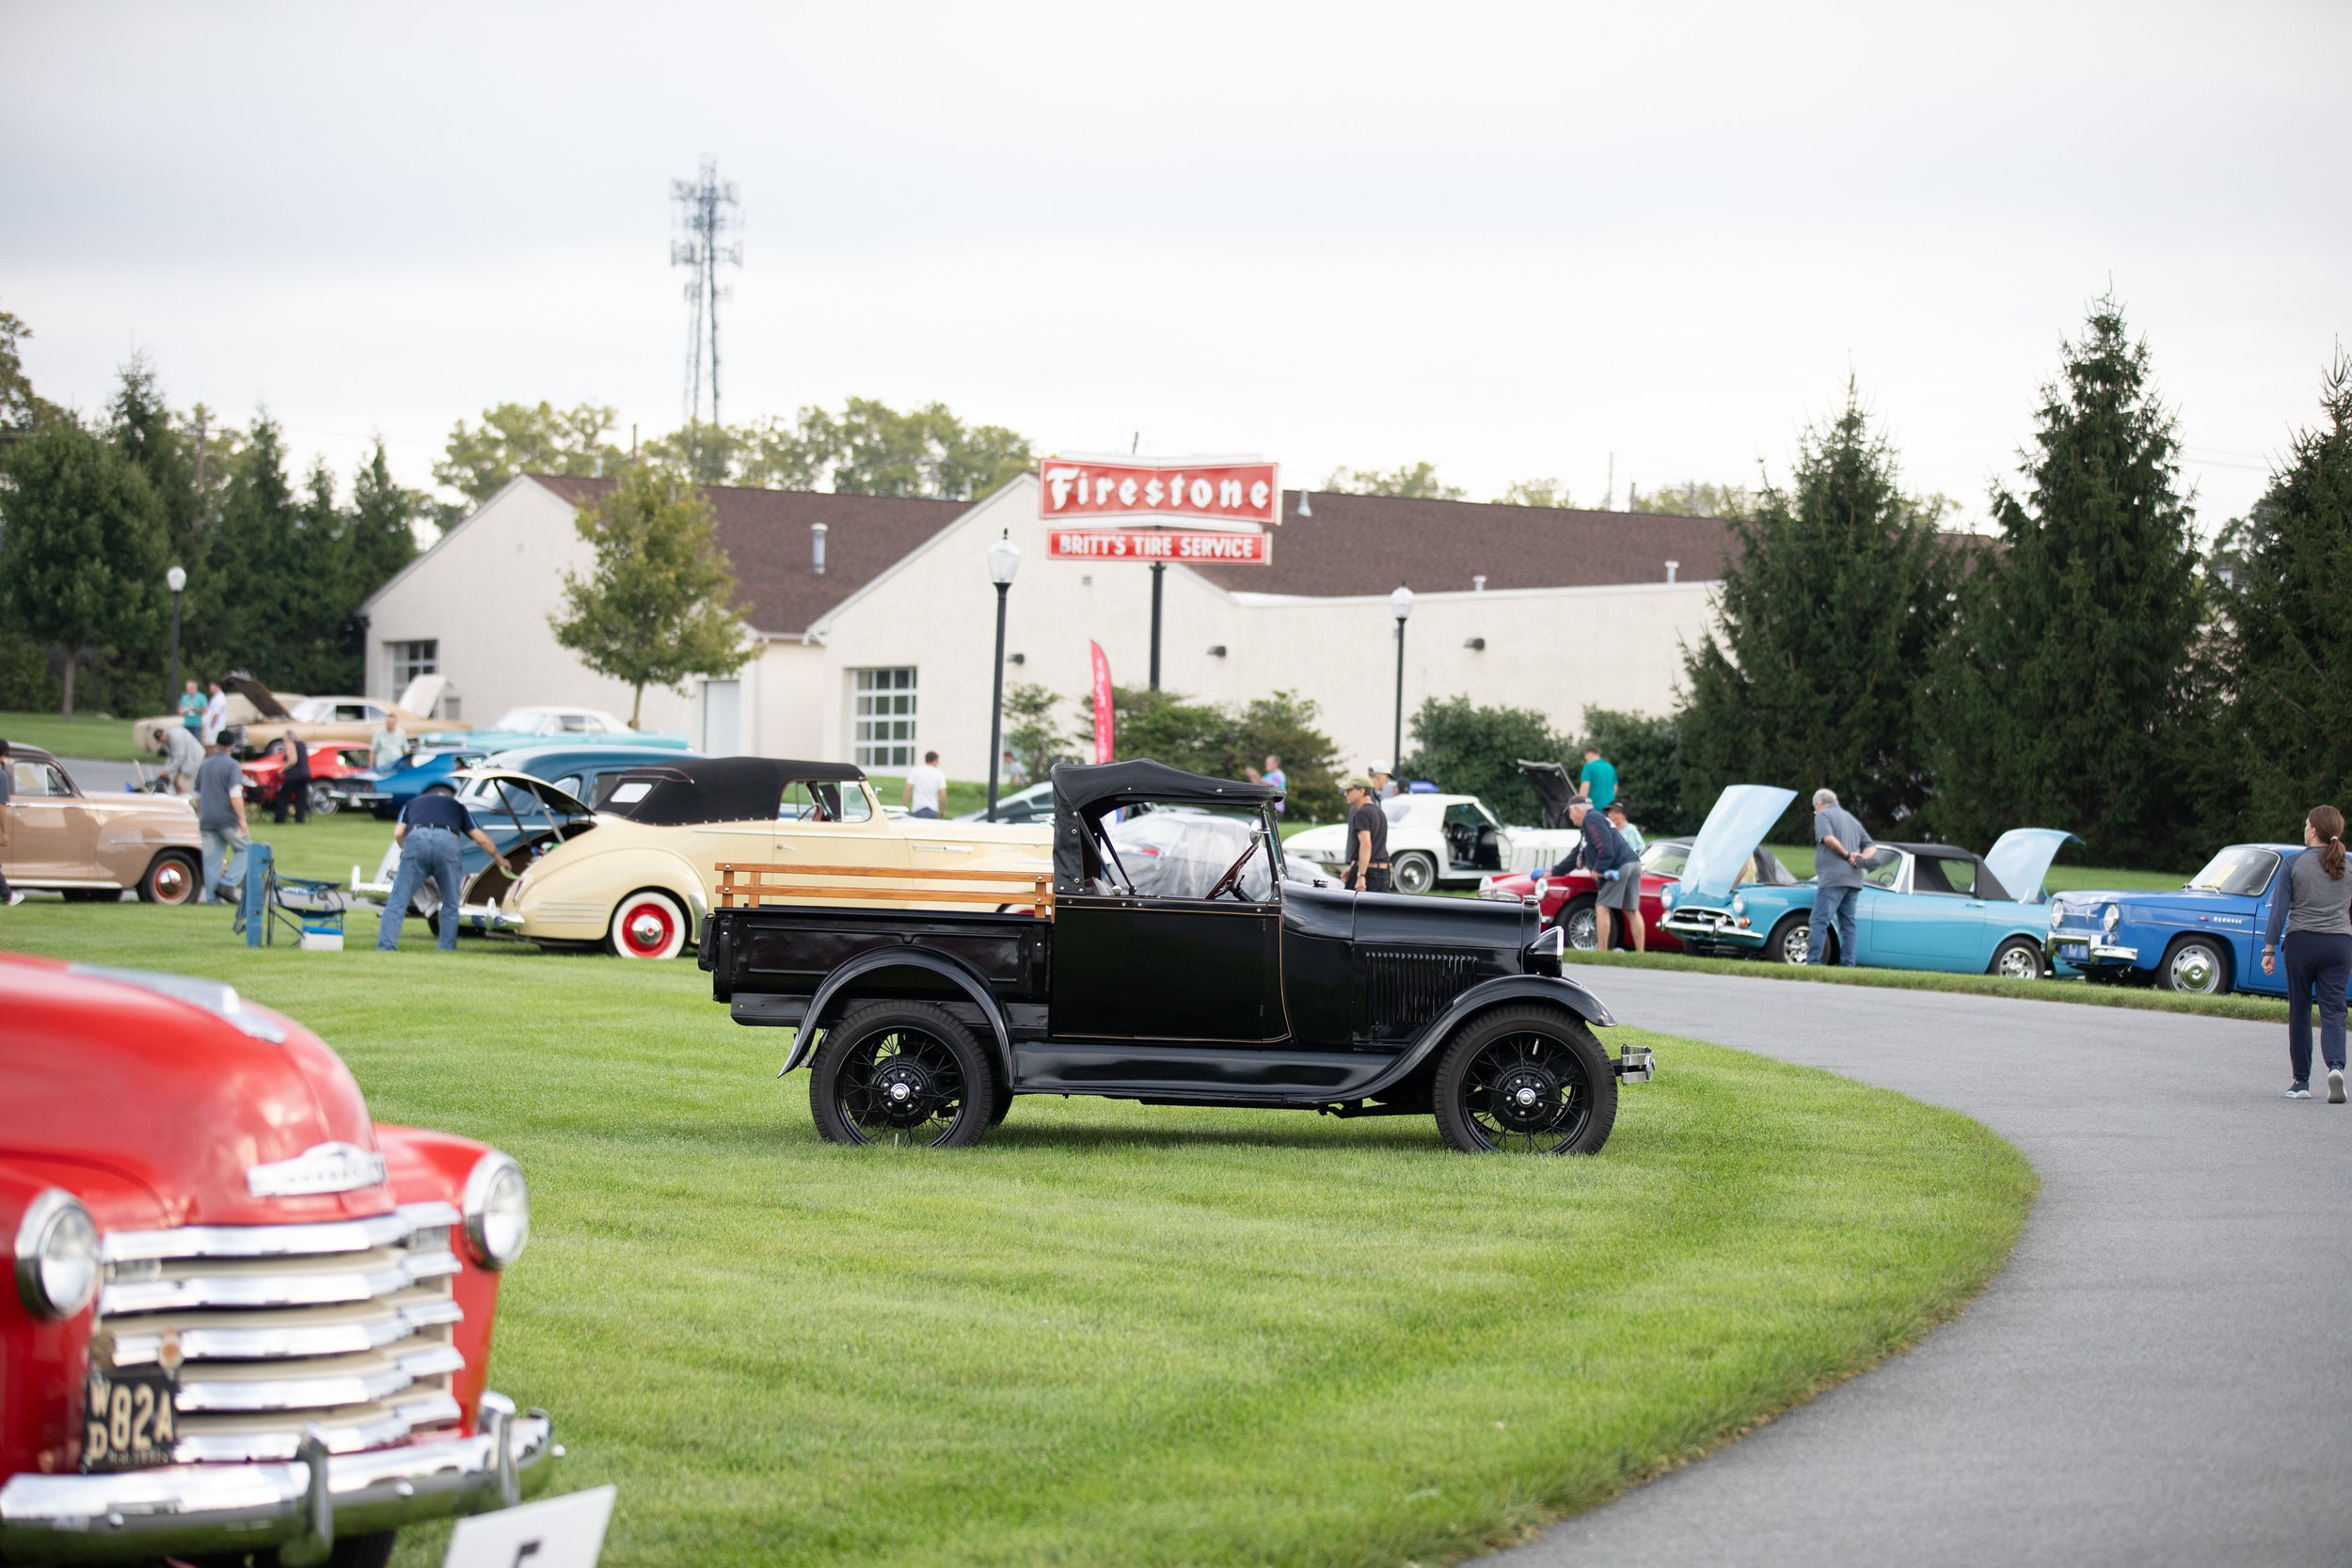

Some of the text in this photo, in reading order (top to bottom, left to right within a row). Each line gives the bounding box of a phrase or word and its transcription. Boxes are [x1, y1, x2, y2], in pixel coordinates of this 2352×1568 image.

[1046, 467, 1269, 510] Firestone
[1059, 534, 1253, 558] BRITT'S TIRE SERVICE
